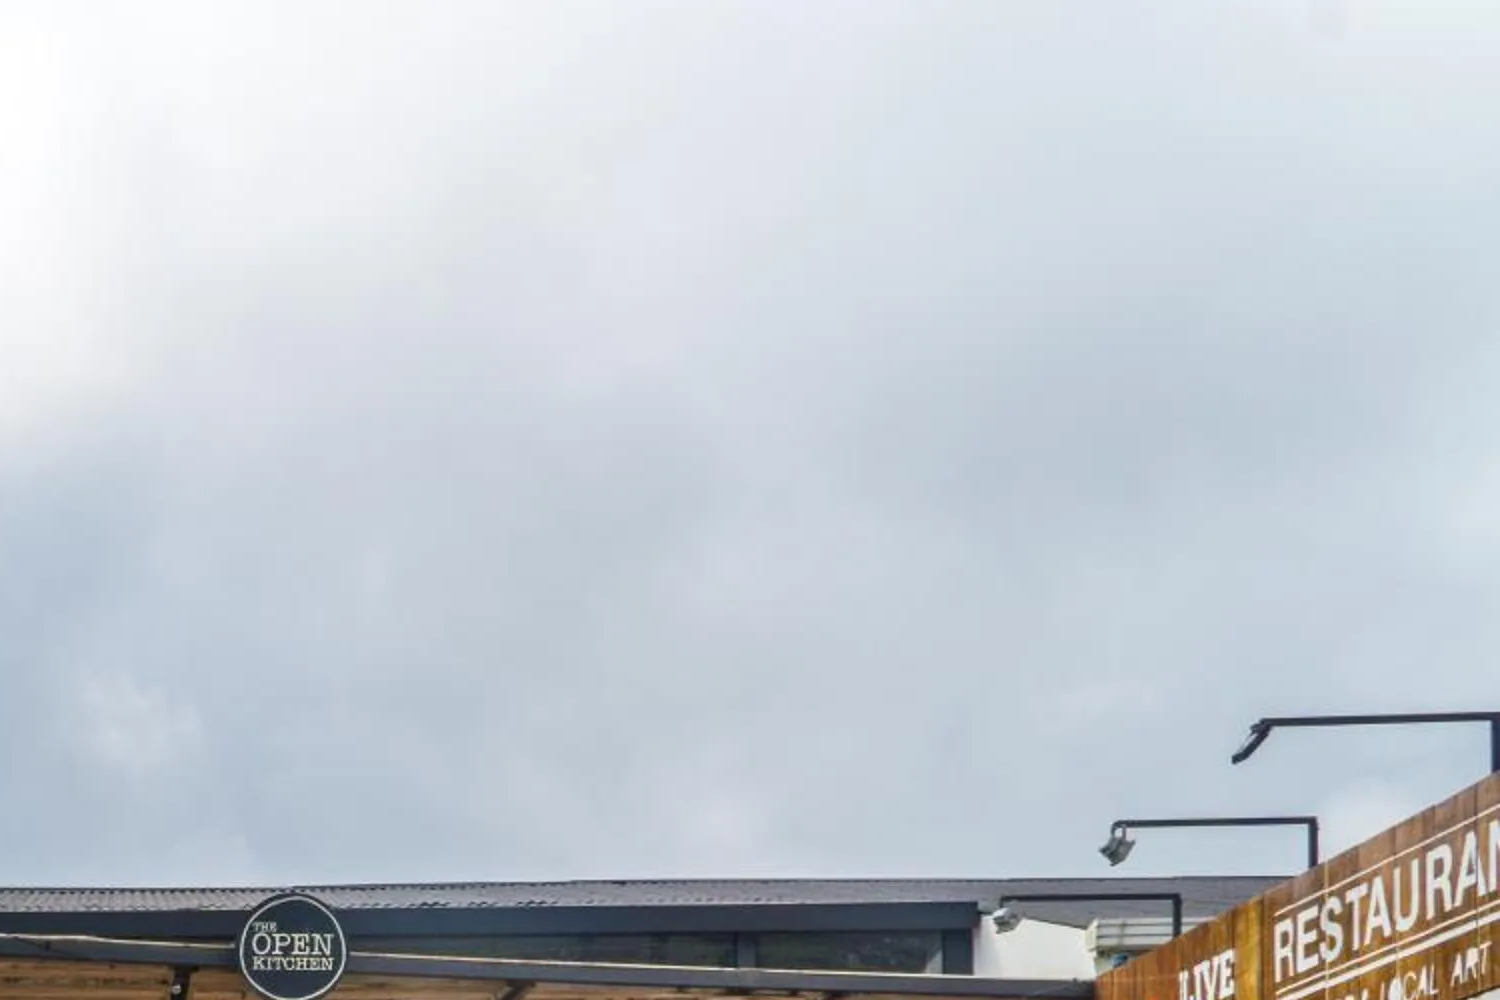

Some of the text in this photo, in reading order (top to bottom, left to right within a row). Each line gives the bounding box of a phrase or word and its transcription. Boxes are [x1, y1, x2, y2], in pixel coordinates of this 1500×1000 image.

[252, 921, 277, 933] THE
[252, 932, 334, 956] OPEN
[252, 956, 335, 971] KITCHEN
[1450, 940, 1493, 988] ART
